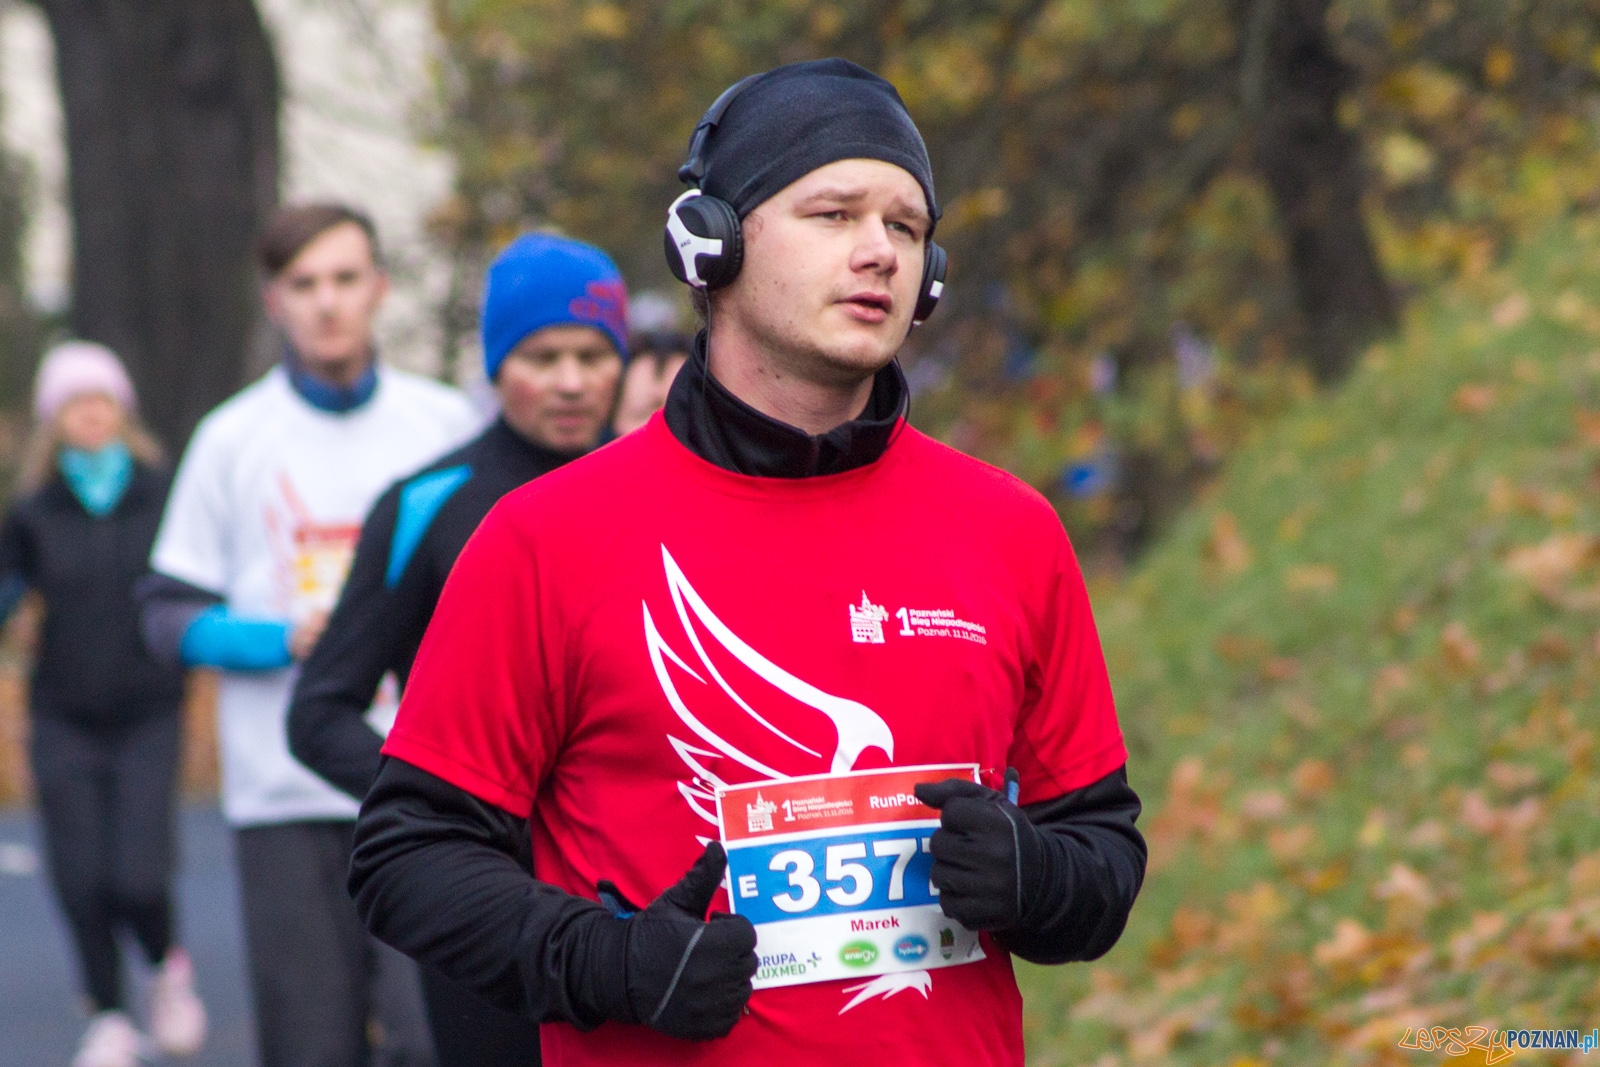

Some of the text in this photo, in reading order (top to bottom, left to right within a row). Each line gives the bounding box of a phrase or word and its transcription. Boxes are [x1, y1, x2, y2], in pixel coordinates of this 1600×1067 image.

[895, 606, 915, 636] 1
[781, 799, 796, 822] 1
[738, 875, 758, 898] E
[851, 915, 900, 932] Marek
[755, 963, 806, 980] LUXMED
